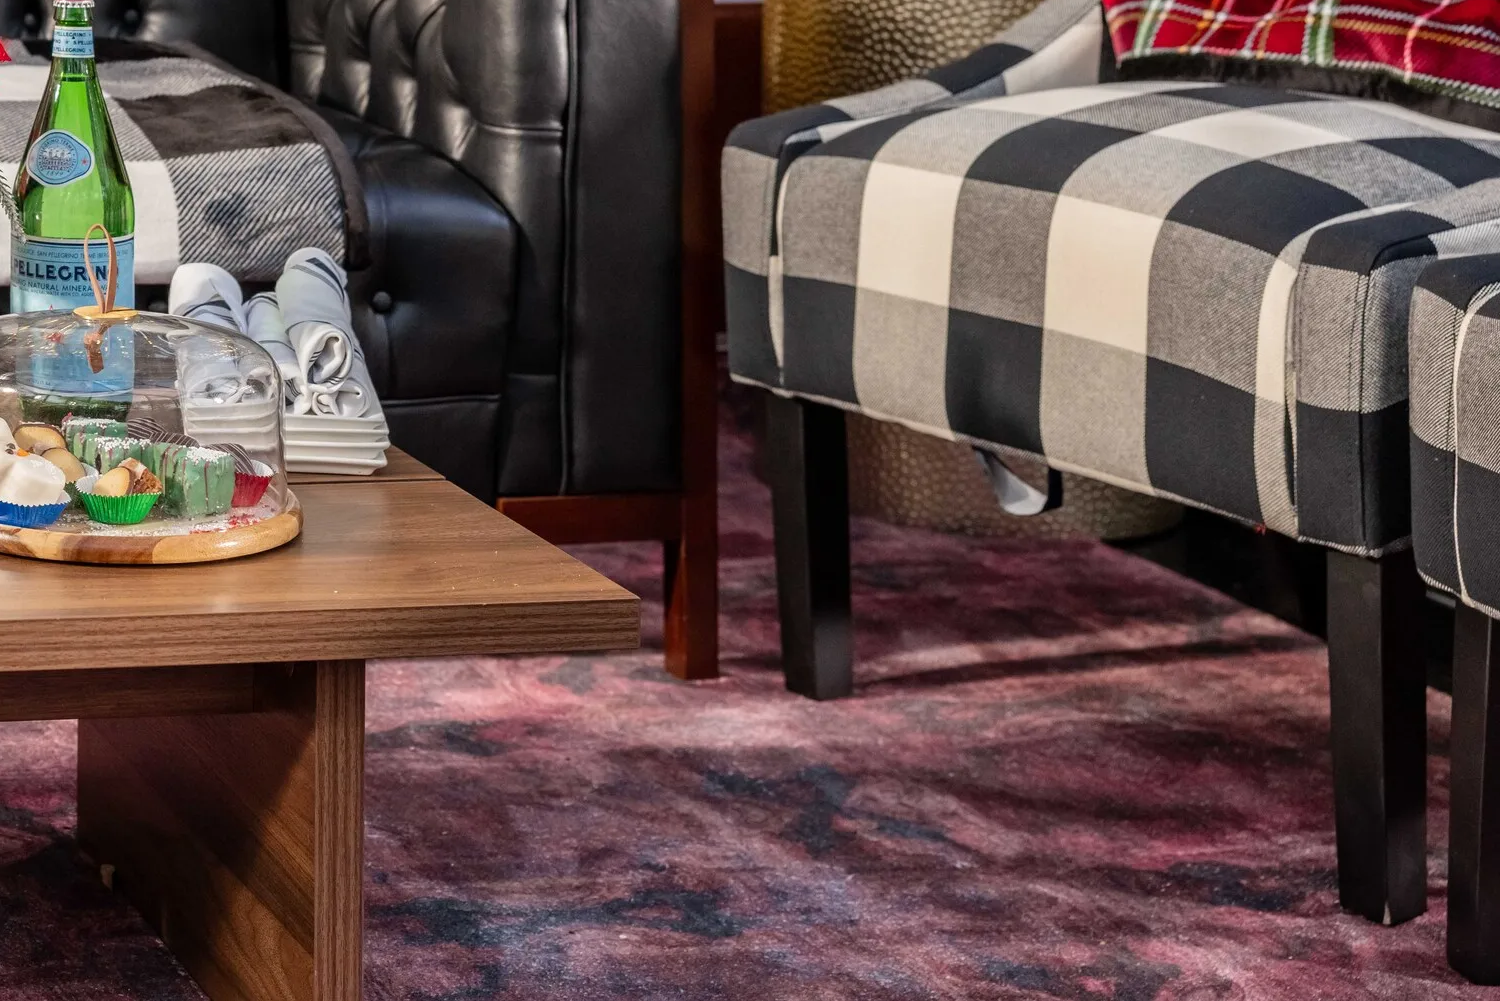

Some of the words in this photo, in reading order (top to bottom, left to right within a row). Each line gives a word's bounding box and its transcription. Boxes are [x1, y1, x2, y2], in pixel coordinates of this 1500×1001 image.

[13, 258, 119, 282] PELLEGRN
[26, 281, 60, 292] NATURAL
[62, 284, 94, 293] MINERA
